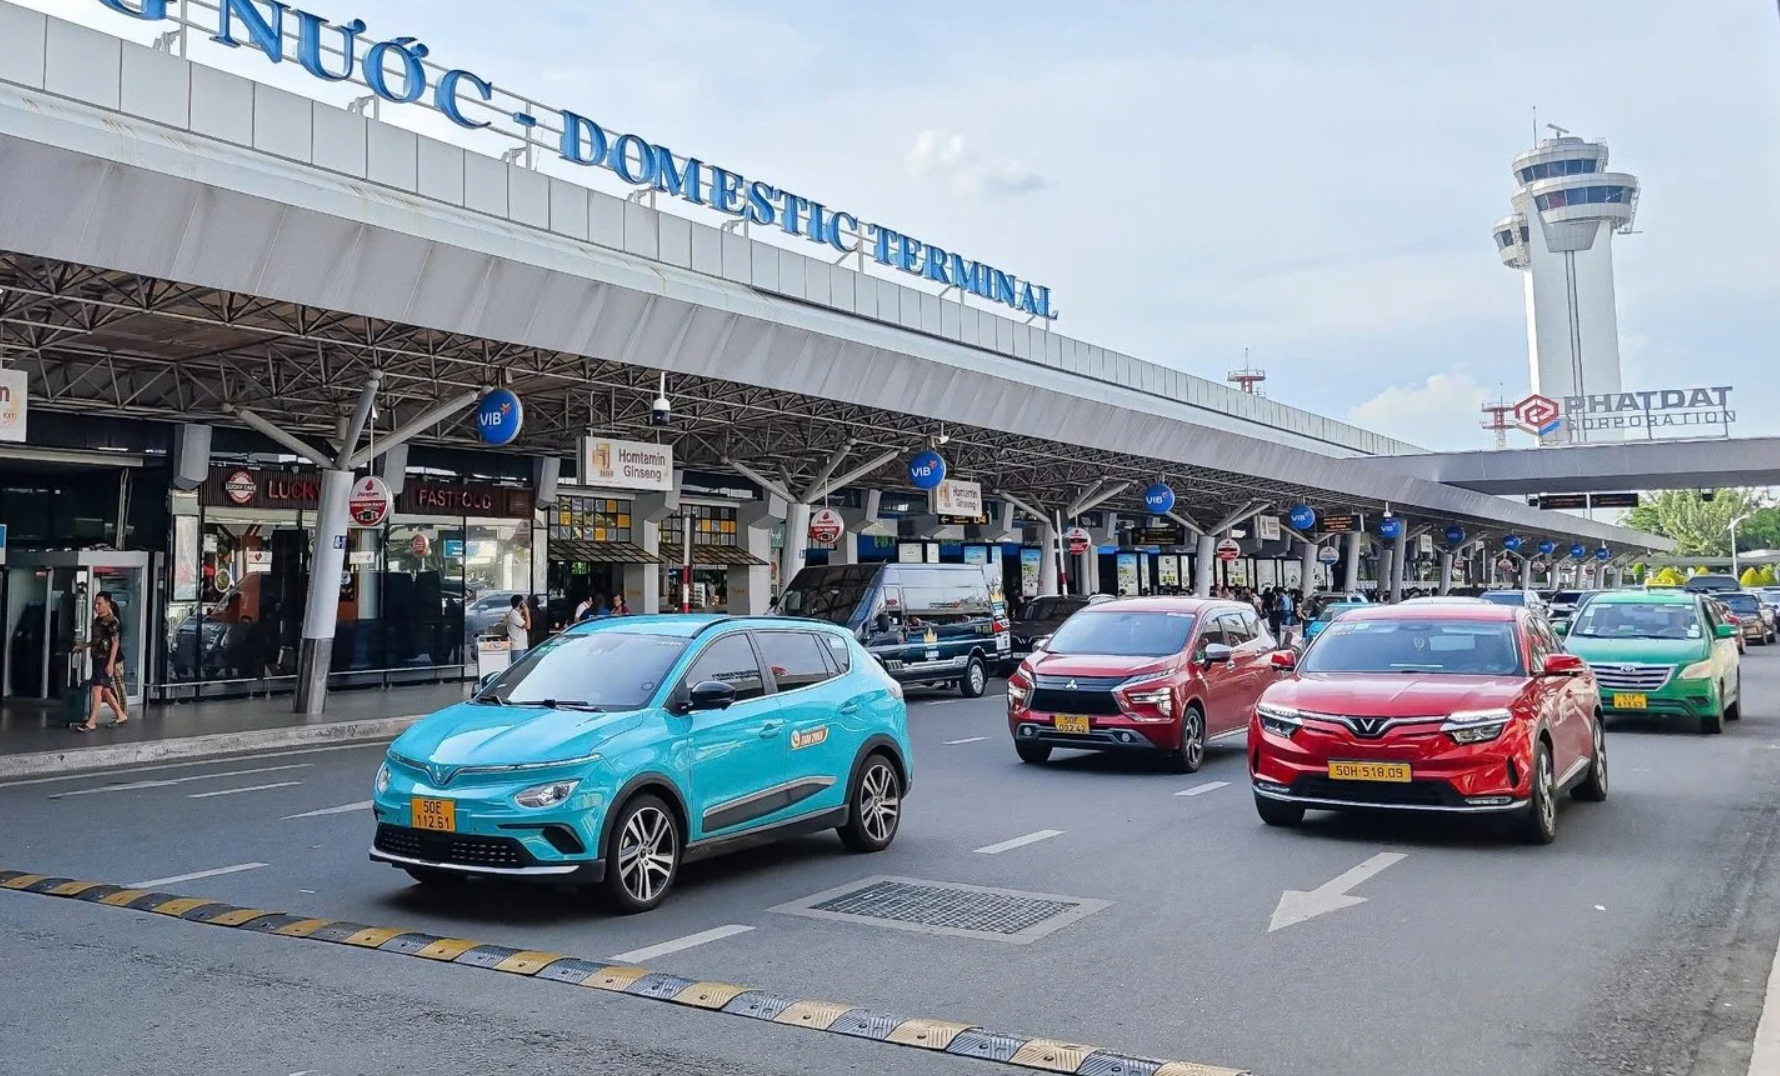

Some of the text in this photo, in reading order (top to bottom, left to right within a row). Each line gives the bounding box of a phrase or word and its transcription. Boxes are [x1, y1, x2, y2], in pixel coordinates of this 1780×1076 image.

[559, 108, 858, 254] DOMESTIC
[867, 222, 1059, 321] TERMINAL
[1564, 386, 1734, 414] PHATDAT
[479, 412, 502, 427] VIB
[1569, 410, 1737, 431] CORPORATION
[618, 448, 667, 467] Homtamin
[623, 465, 662, 482] Ginseng
[911, 466, 932, 478] VIB
[1146, 496, 1163, 505] VIB
[1336, 765, 1404, 779] 50H-518.09
[423, 800, 442, 815] 50E
[416, 814, 450, 829] 112.61
